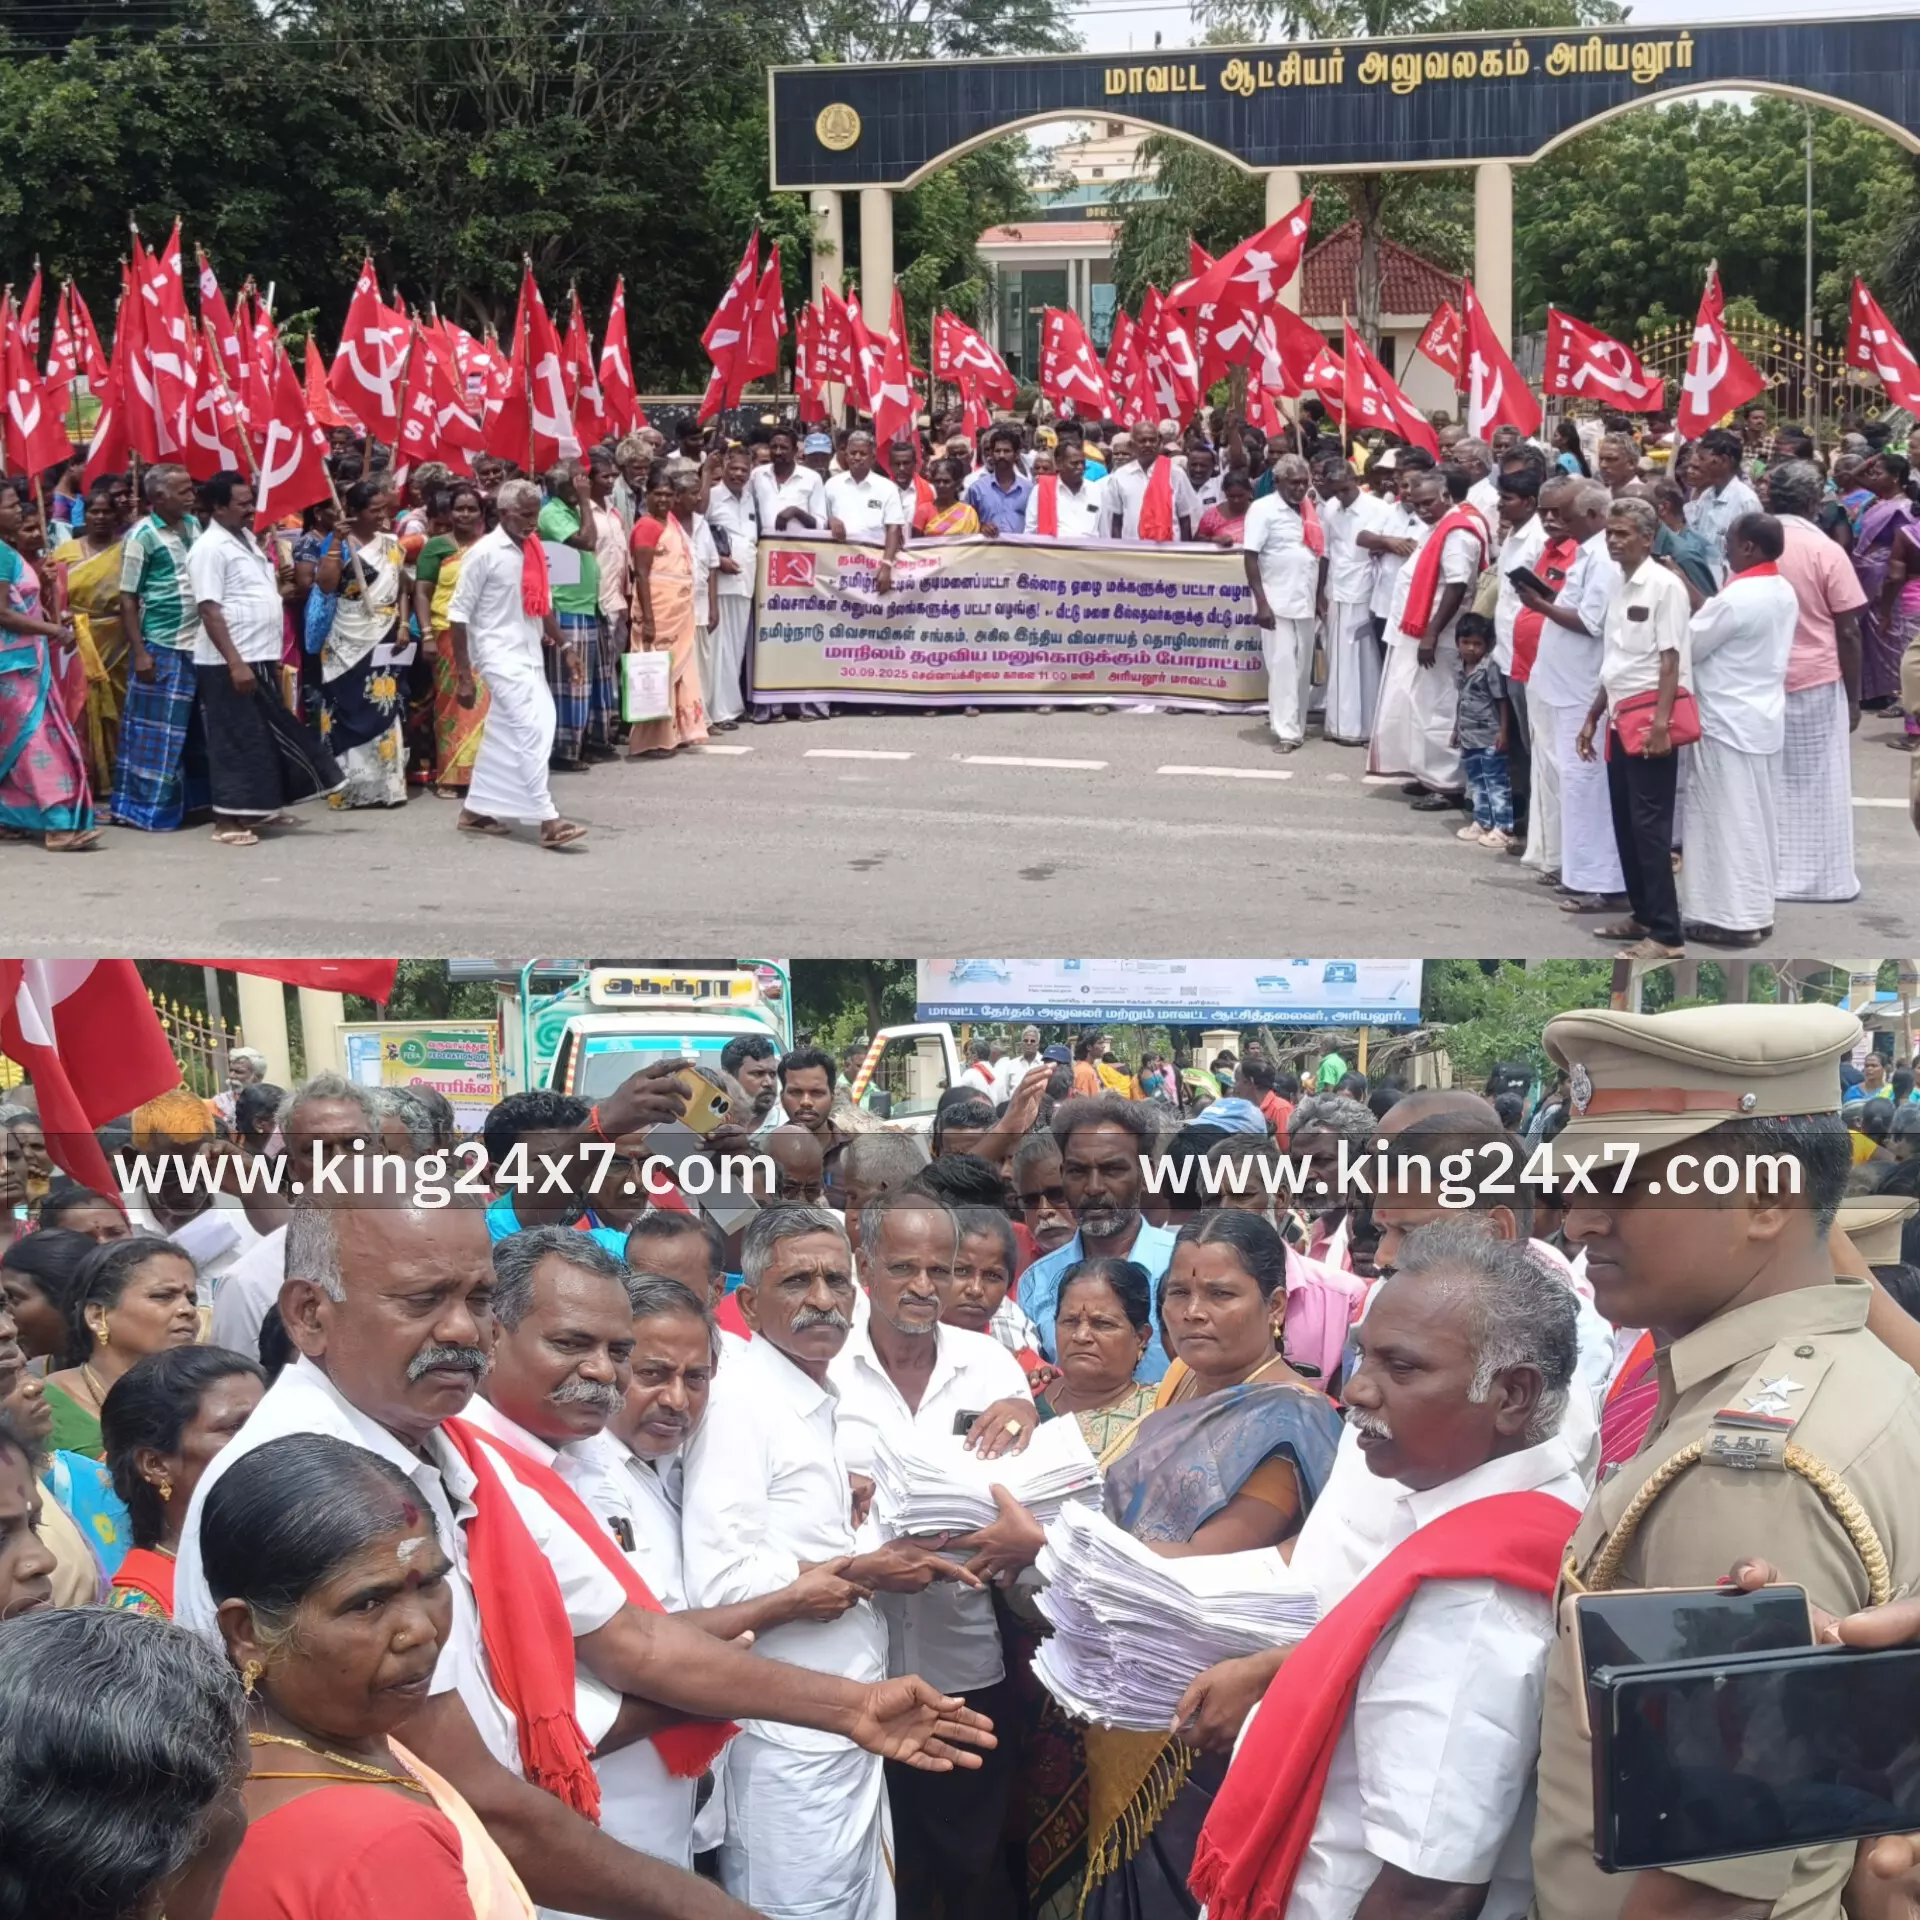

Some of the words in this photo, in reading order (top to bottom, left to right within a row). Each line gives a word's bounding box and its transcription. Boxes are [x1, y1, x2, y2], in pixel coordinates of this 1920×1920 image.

[1105, 62, 1206, 96] மாவட்ட
[1220, 48, 1346, 97] ஆட்சியர்
[1357, 38, 1530, 94] அலுவலகம்
[1545, 30, 1695, 83] அரியலூர்
[1044, 316, 1065, 384] AIKS
[1111, 321, 1135, 384] AIKS
[1555, 319, 1574, 389] AIKS
[770, 551, 779, 585] AIKS
[1182, 583, 1216, 597] பட்டா
[964, 602, 992, 616] பட்டா
[759, 622, 824, 643] தமிழ்நாடு
[829, 623, 916, 642] விவசாயிகள்
[974, 627, 1010, 643] அகில
[1014, 626, 1063, 648] இந்திய
[1142, 631, 1229, 651] தொழிலாளர்
[825, 644, 906, 662] மாநிலம்
[910, 647, 987, 667] தழுவிய
[1156, 650, 1262, 672] போராட்டம்
[840, 667, 909, 680] 30.09.2025
[1108, 670, 1167, 687] அரியலூர்
[928, 1006, 978, 1017] மாவட்ட
[981, 1004, 1035, 1018] தேர்தல்
[1038, 1006, 1102, 1020] அலுவலர்
[1106, 1006, 1155, 1022] மற்றும்
[1158, 1009, 1207, 1021] மாவட்ட
[427, 1052, 473, 1060] FEDERATION
